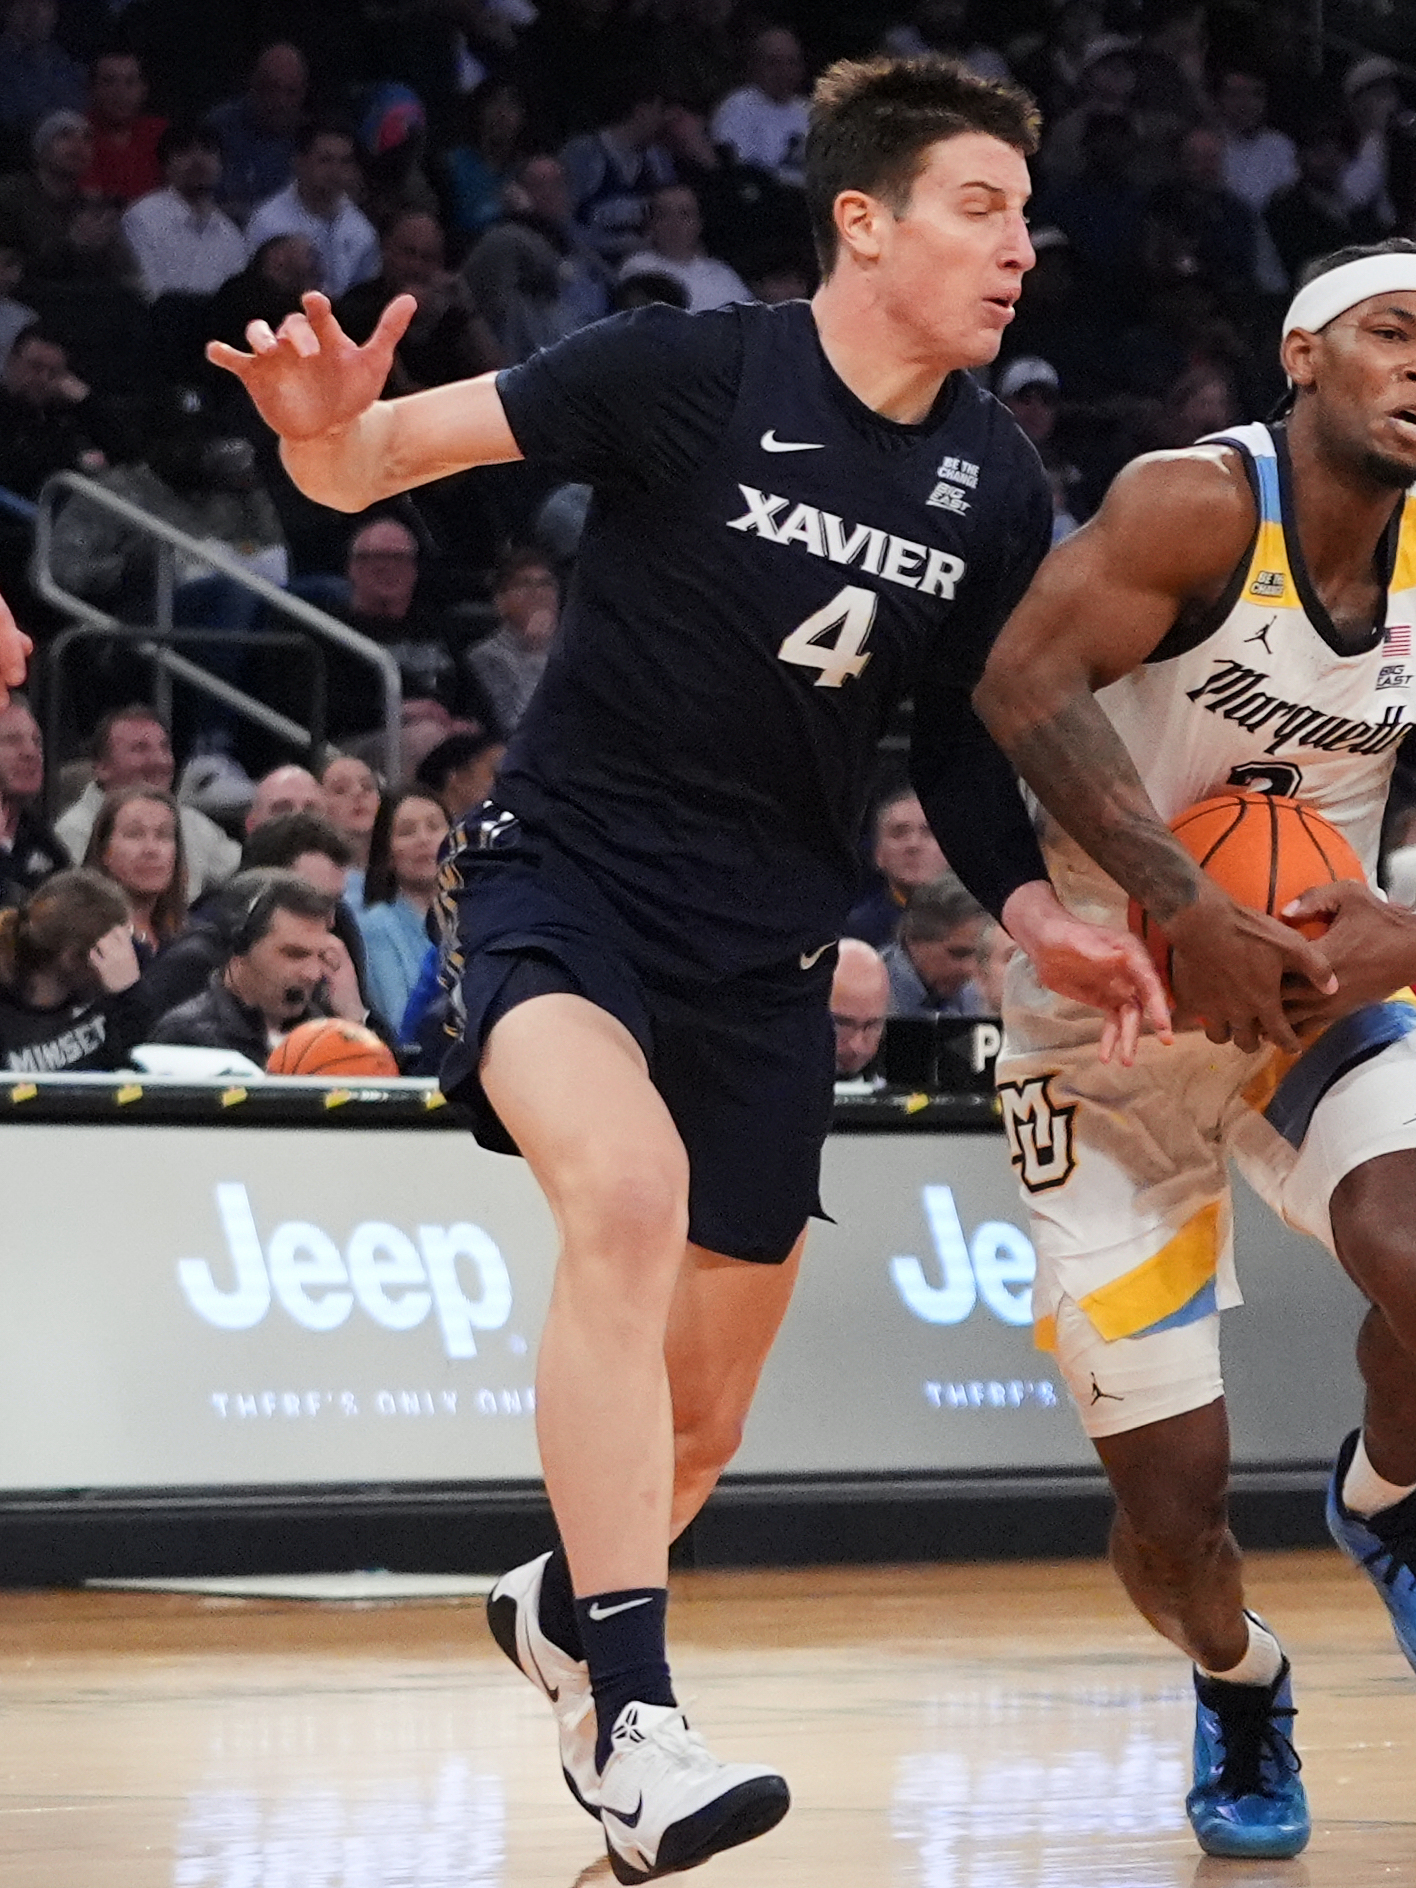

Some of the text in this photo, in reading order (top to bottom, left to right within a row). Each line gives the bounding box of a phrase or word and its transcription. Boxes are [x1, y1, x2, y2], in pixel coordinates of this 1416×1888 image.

[929, 491, 971, 511] EAST
[934, 481, 966, 499] BIG
[943, 456, 980, 477] BE THE
[726, 483, 967, 600] XAVIER
[777, 584, 879, 688] 4
[178, 1182, 514, 1358] Jeep
[890, 1185, 1035, 1324] Je
